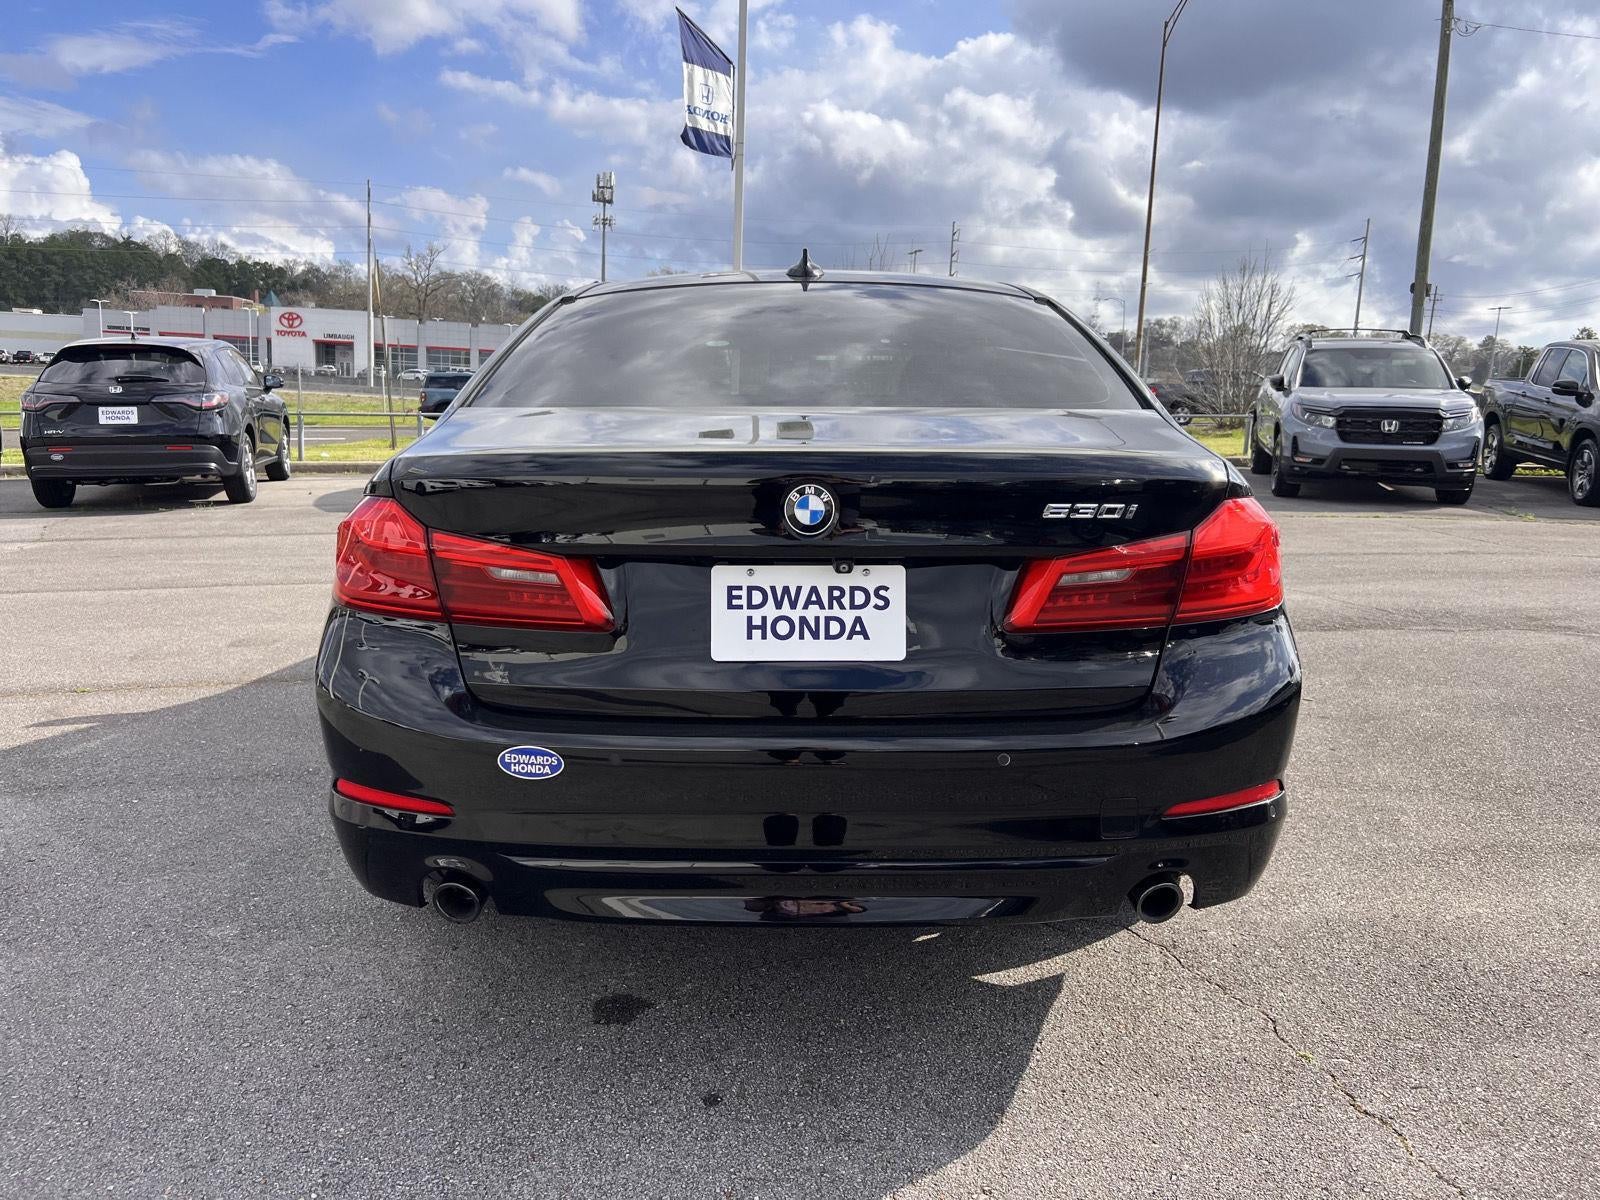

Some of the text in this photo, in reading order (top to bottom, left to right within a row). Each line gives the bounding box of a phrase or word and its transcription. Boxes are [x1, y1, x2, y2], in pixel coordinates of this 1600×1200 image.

[275, 330, 308, 338] TOYOTA
[790, 486, 830, 502] BMW
[726, 585, 891, 611] EDWARDS
[746, 615, 871, 641] HONDA
[504, 753, 558, 766] EDWARDS
[511, 763, 552, 775] HONDA
